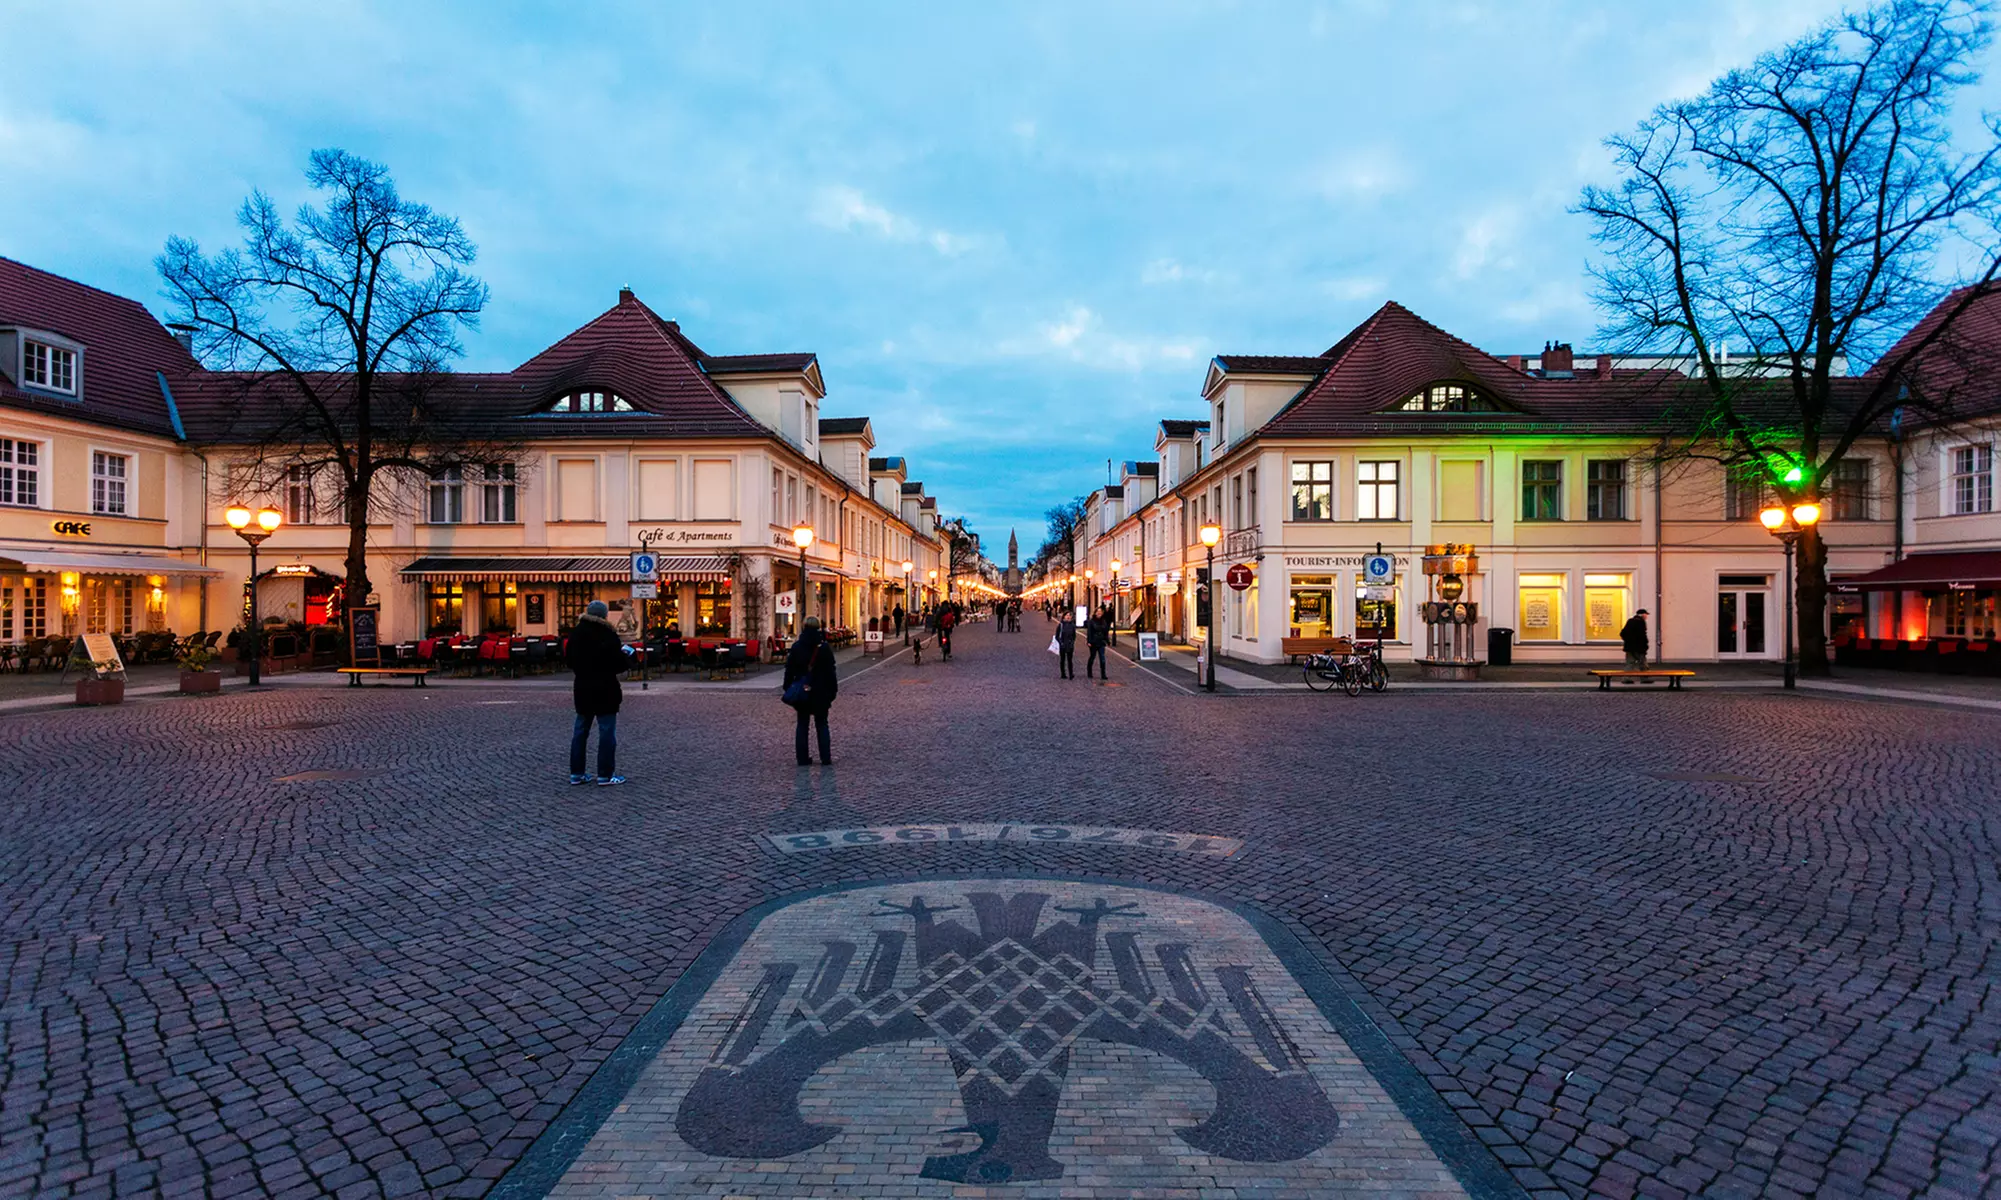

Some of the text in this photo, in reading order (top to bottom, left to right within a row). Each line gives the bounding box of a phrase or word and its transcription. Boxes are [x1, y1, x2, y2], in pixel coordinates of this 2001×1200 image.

[54, 521, 91, 535] CAFE
[638, 528, 733, 544] Café & Apartments
[786, 826, 1226, 851] 1976/1998
